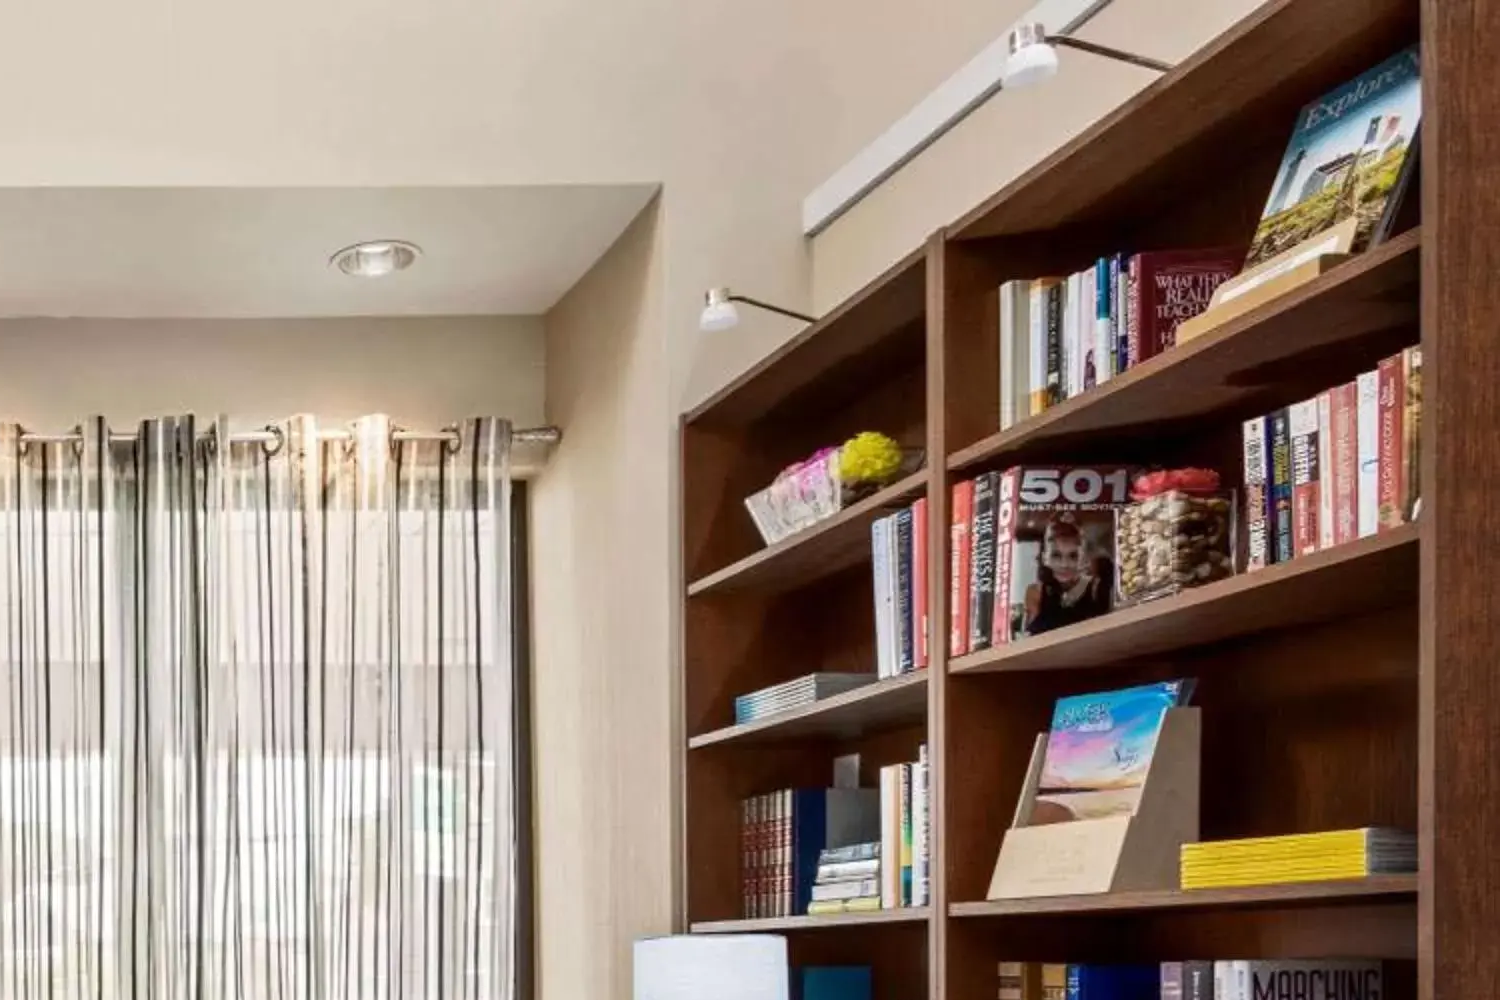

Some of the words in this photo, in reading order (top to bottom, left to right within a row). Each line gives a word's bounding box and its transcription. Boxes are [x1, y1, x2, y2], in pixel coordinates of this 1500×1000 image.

[1155, 275, 1194, 289] WHAT
[1165, 287, 1210, 304] REALL
[1156, 304, 1198, 319] TEACH
[1019, 468, 1128, 504] 501
[997, 474, 1014, 546] 501
[977, 509, 994, 538] THE
[978, 540, 994, 575] LIVES
[978, 577, 993, 593] OF
